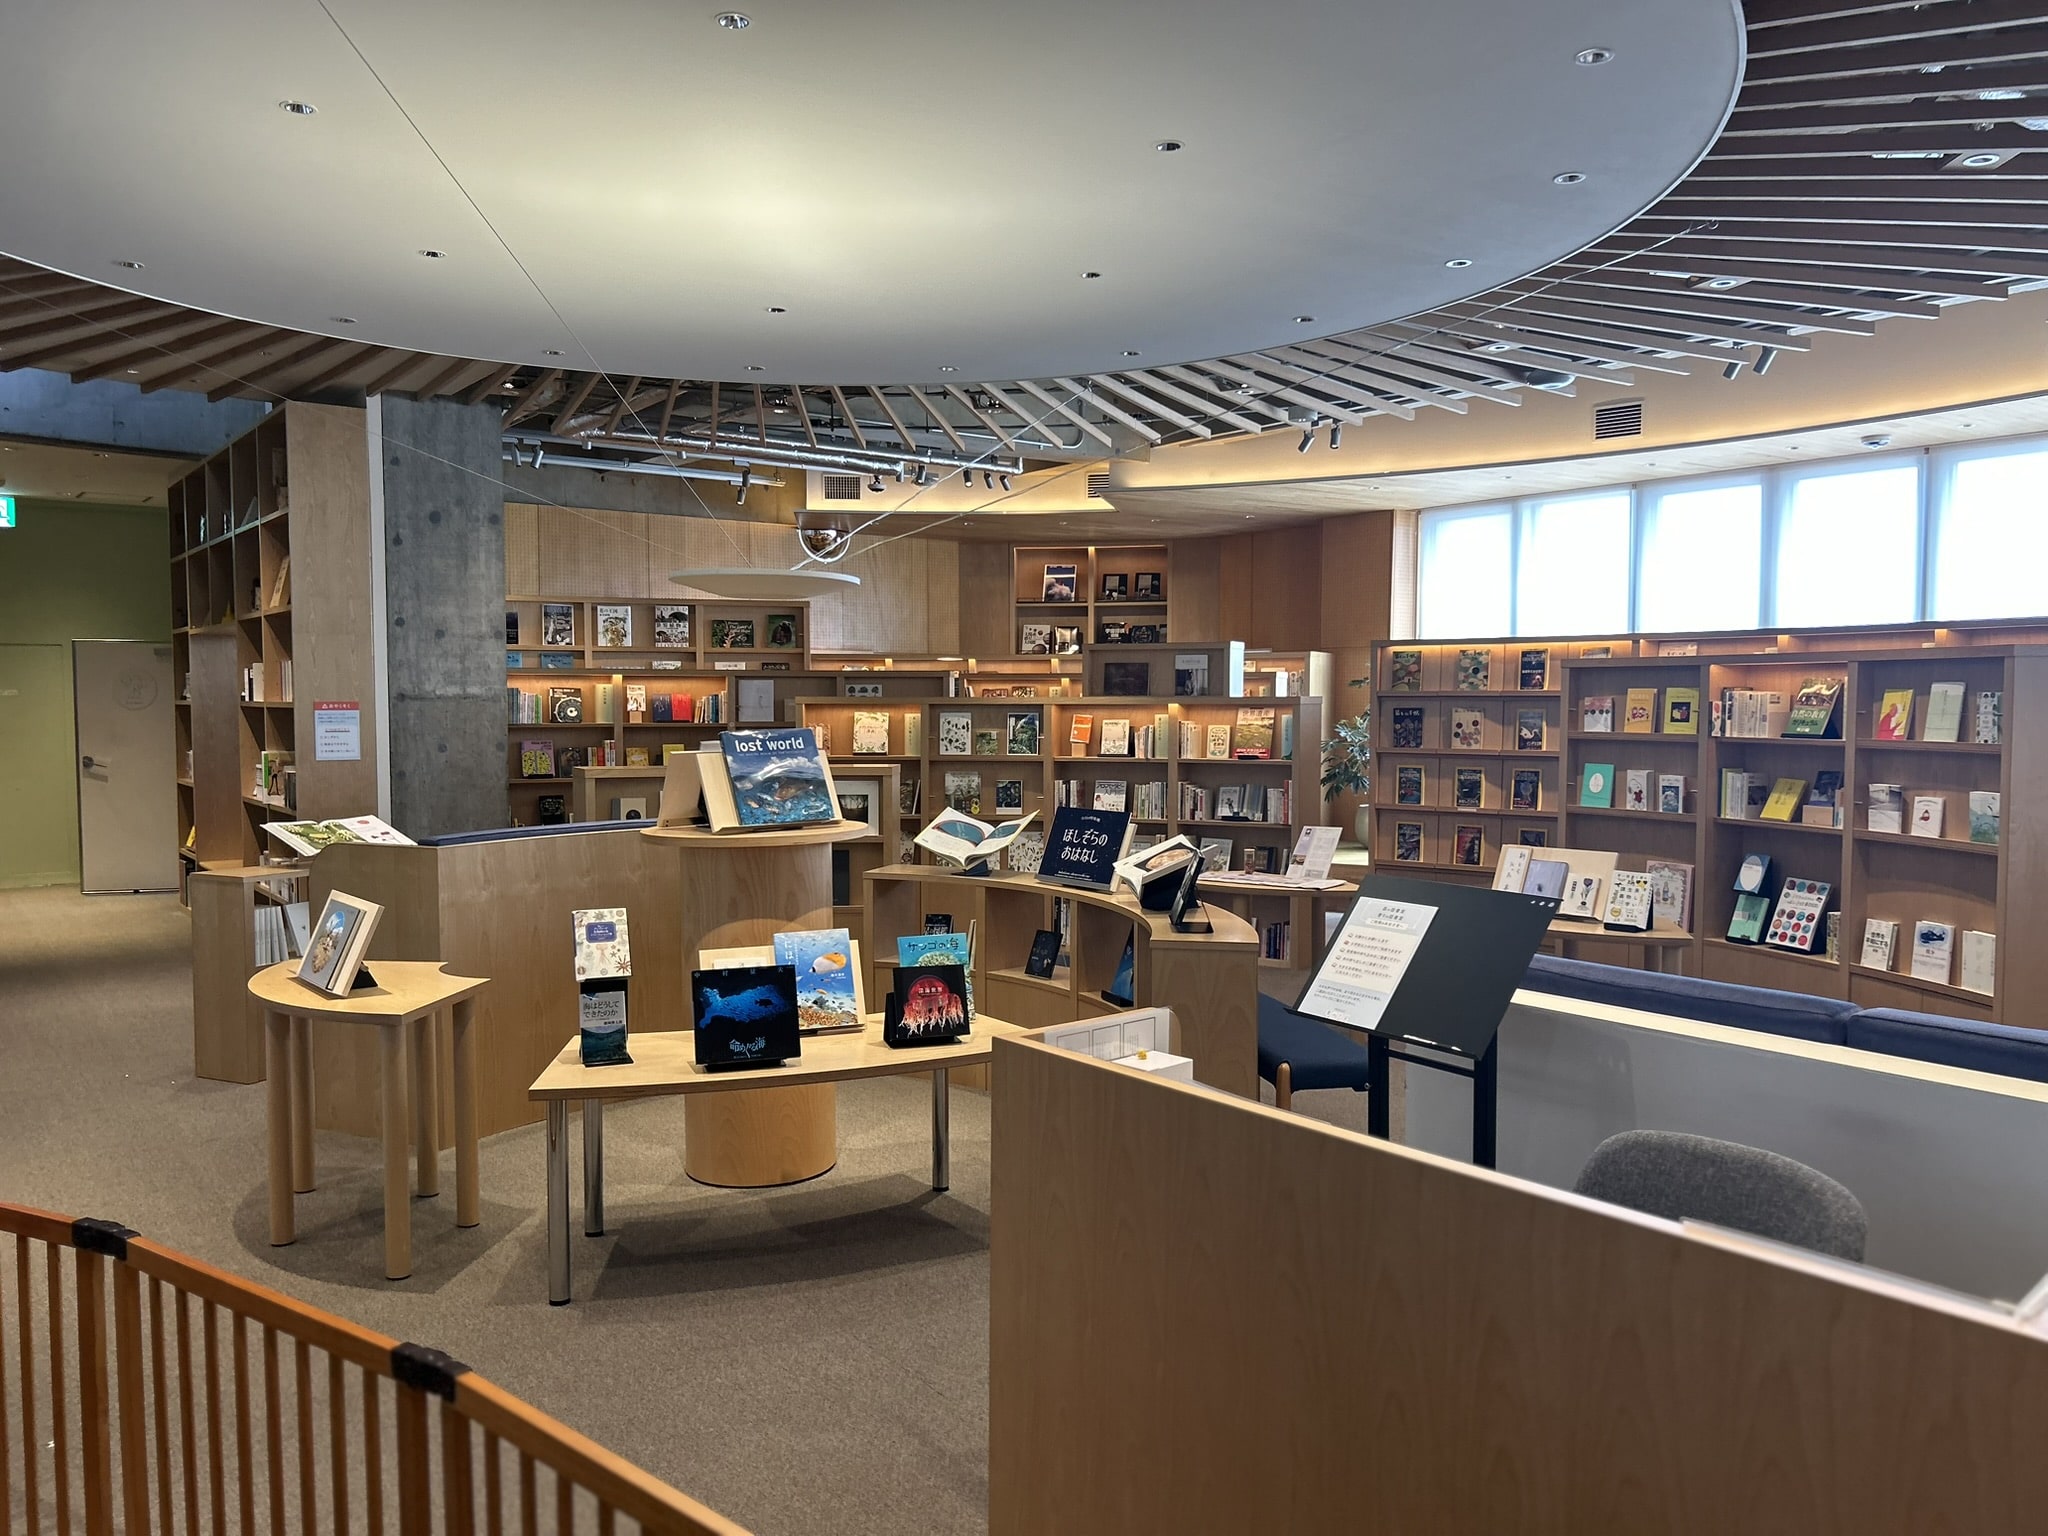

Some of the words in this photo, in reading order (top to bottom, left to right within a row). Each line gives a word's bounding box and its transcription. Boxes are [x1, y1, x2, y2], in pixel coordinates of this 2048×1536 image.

[735, 738, 763, 753] lost
[766, 736, 805, 751] world
[1062, 828, 1108, 847] ほしぞらの
[1061, 845, 1098, 864] おはなし
[908, 937, 959, 952] サンゴの海
[583, 1000, 620, 1011] 海はどうして
[583, 1009, 618, 1019] できたのか
[728, 1036, 766, 1059] 命めぐる海
